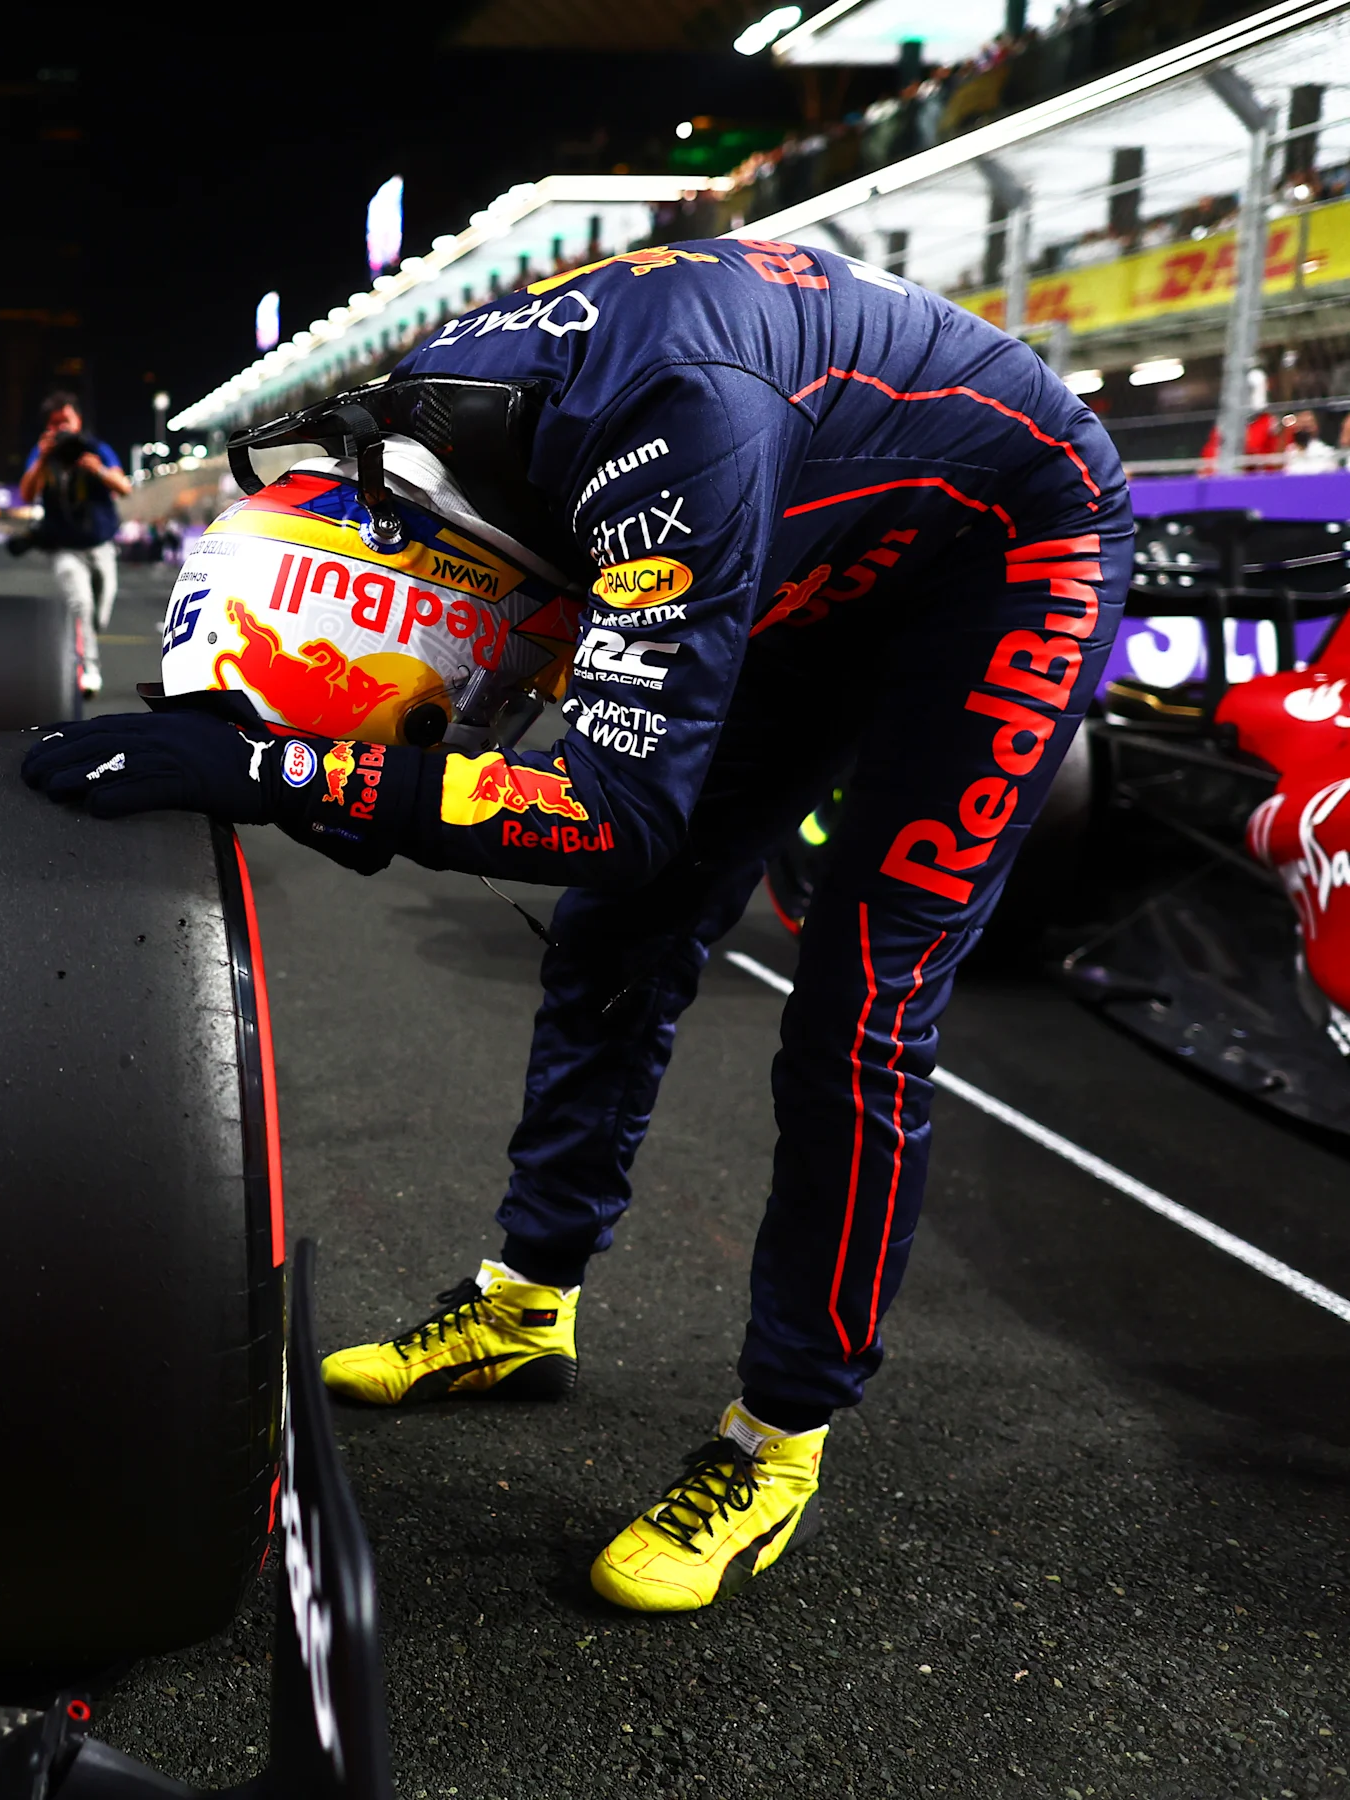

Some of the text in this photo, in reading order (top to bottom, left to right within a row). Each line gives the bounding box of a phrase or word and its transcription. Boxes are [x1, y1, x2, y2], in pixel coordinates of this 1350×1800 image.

[431, 556, 499, 597] KAVAK
[607, 569, 674, 594] RAUCH
[595, 671, 664, 691] RACING
[591, 699, 667, 735] ARCTIC
[592, 721, 659, 758] WOLF
